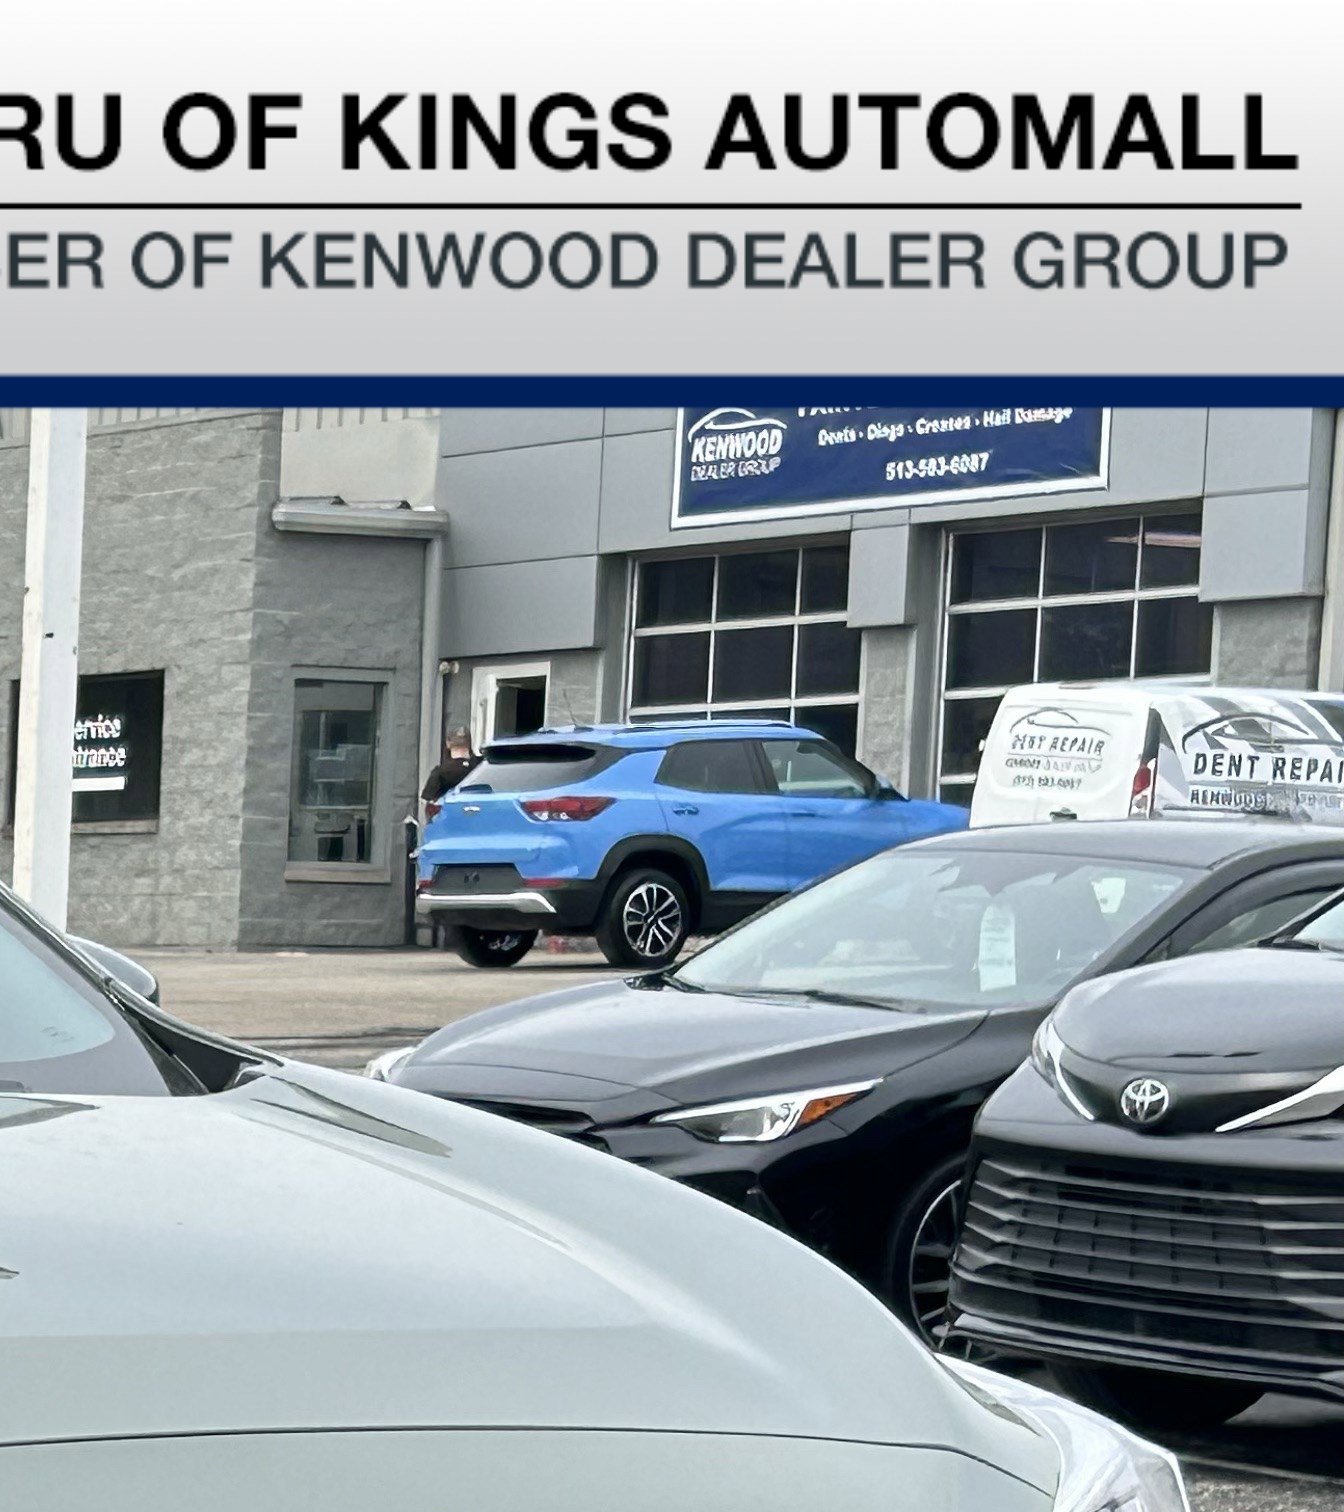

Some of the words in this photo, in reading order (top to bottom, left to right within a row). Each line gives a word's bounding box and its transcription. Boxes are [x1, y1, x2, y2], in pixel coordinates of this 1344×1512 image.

[691, 428, 783, 463] KENWOOD
[74, 714, 121, 740] ervice
[1193, 753, 1260, 779] DENT
[1272, 756, 1344, 784] REPAI
